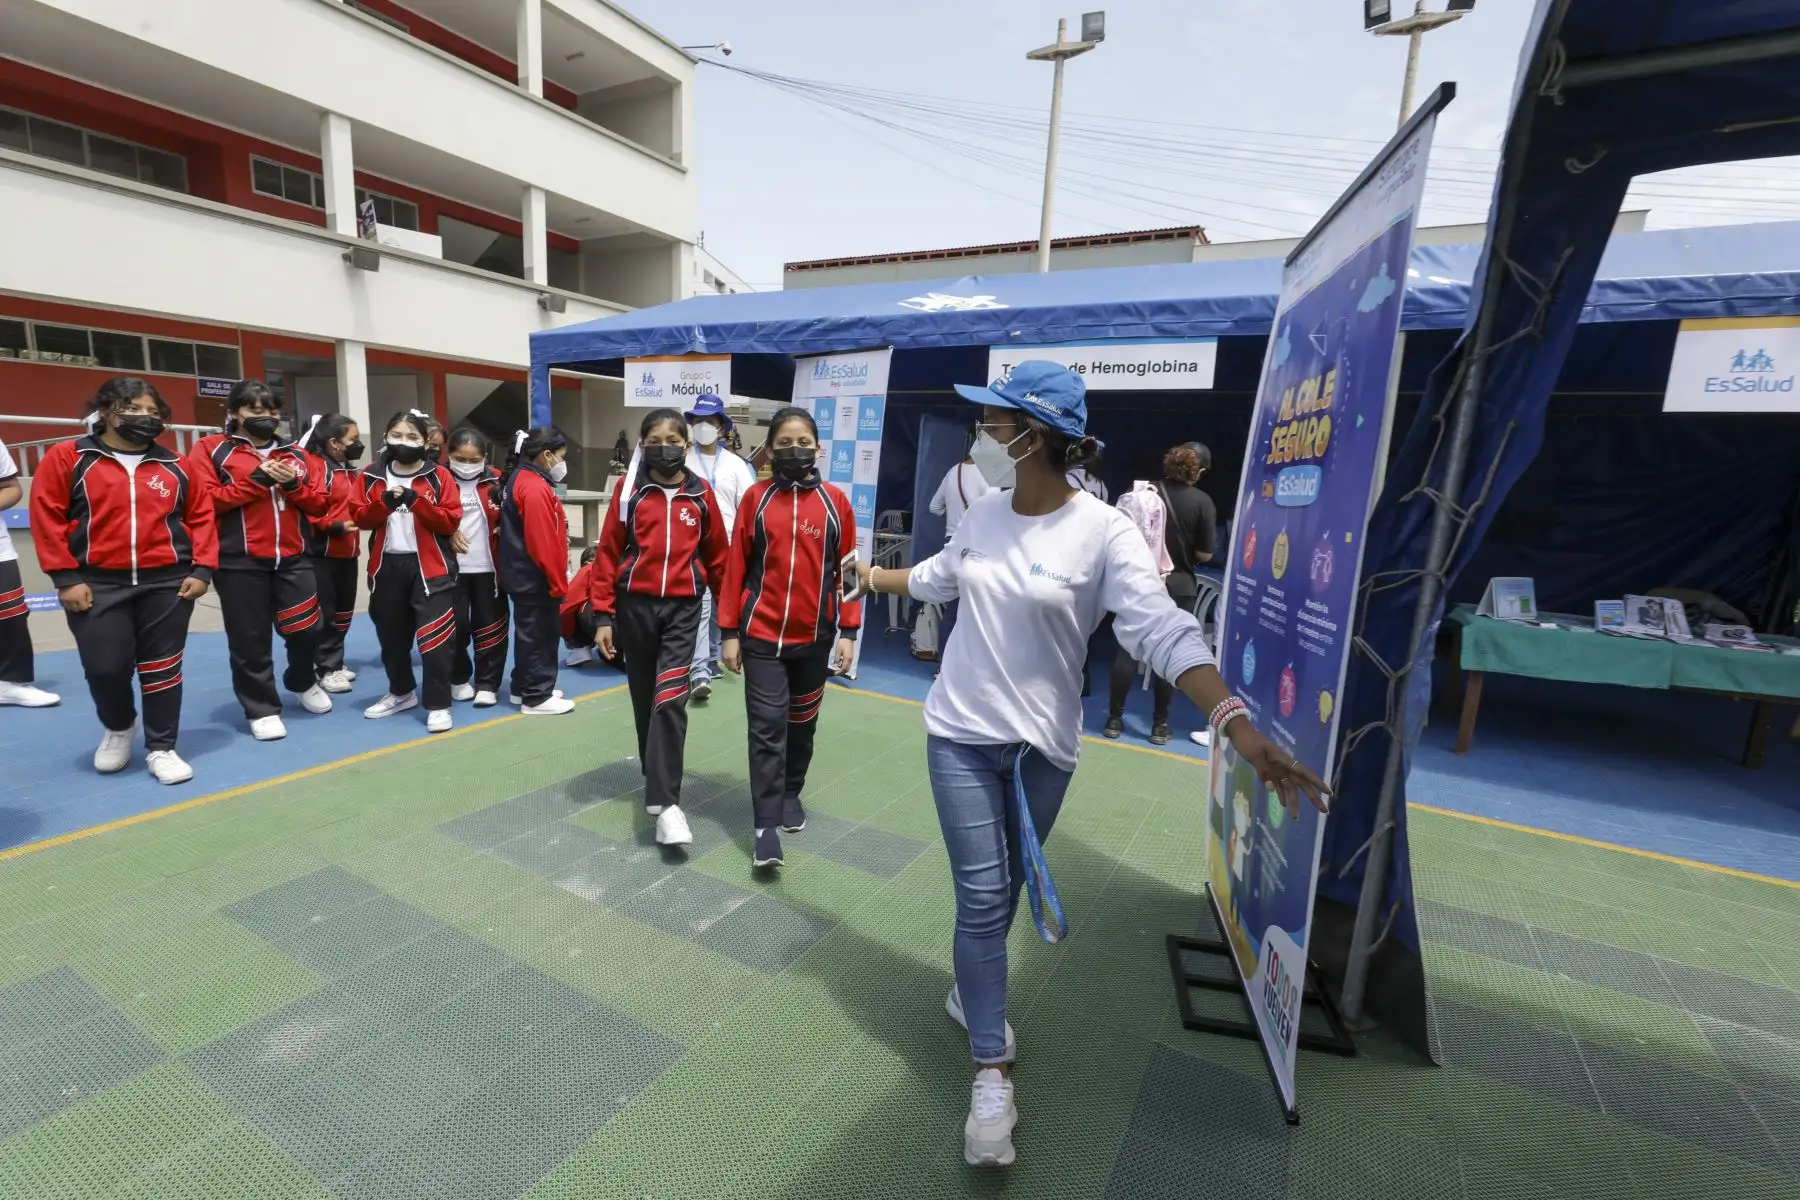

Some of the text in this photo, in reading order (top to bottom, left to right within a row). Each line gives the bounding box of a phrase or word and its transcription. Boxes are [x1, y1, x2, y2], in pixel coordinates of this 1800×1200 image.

[680, 371, 711, 381] Grupo C
[831, 360, 868, 378] EsSalud
[1091, 359, 1198, 377] Hemoglobina
[635, 388, 663, 398] EsSalud
[671, 383, 720, 395] Módulo 1
[1295, 369, 1336, 416] COLE
[1704, 375, 1795, 393] EsSalud
[1266, 415, 1332, 464] SEGURO
[1277, 472, 1319, 496] EsSalud
[1044, 568, 1072, 585] EsSalud
[1267, 940, 1298, 1023] TODOS
[1264, 972, 1292, 1050] VUELVEN
